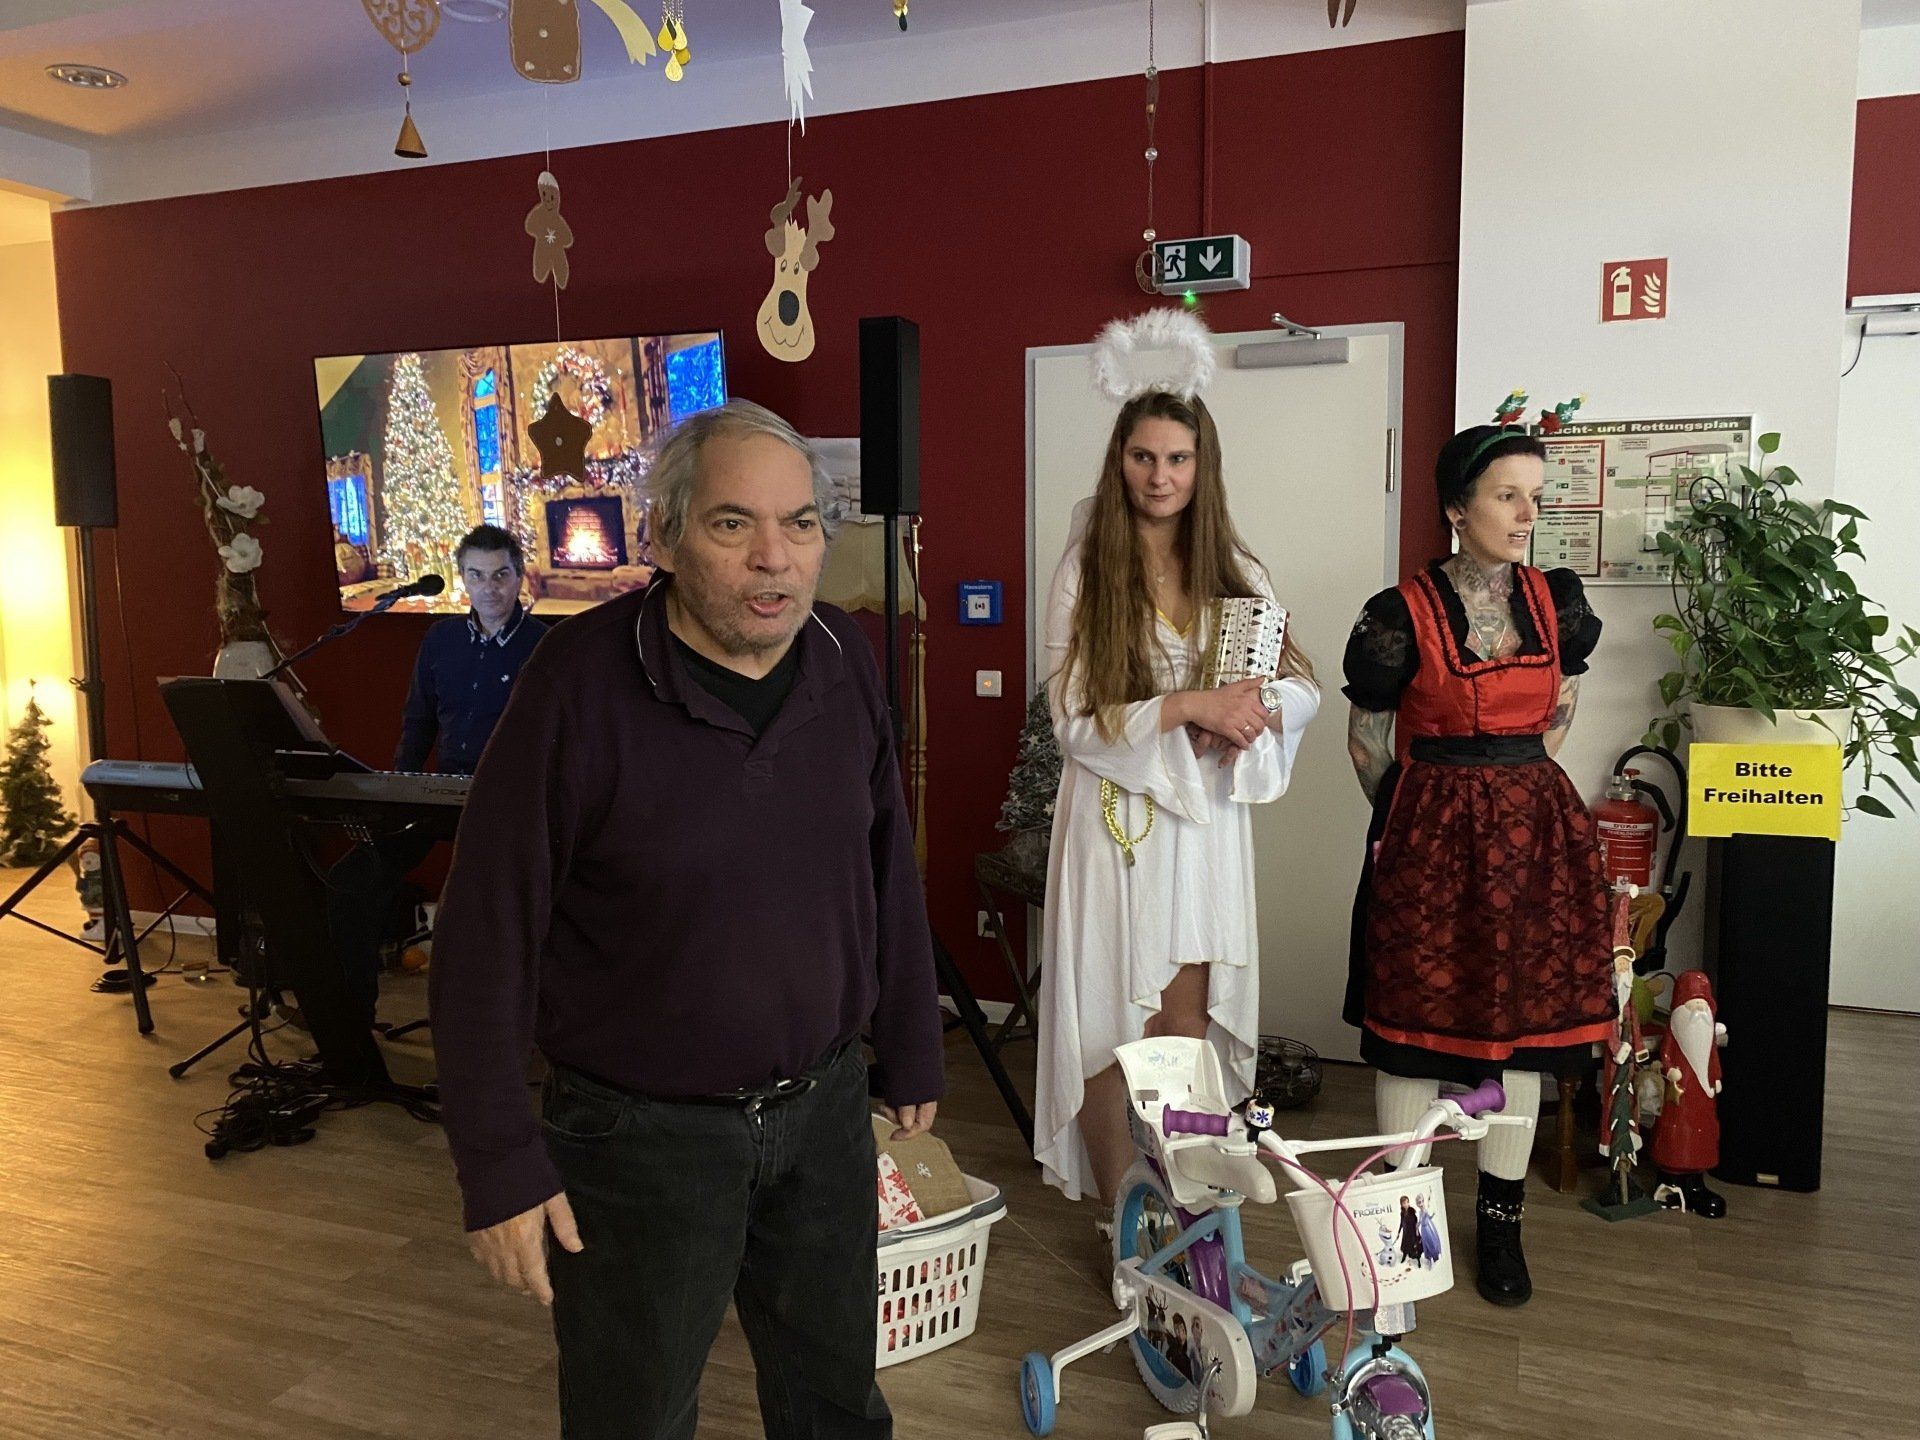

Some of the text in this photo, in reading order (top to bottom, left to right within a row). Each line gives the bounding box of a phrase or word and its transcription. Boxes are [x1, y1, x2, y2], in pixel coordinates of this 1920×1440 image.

[1539, 420, 1739, 435] ucht- und Rettungsplan
[1735, 763, 1793, 778] Bitte
[1704, 788, 1824, 805] Freihalten
[1353, 1206, 1386, 1218] FROZEN
